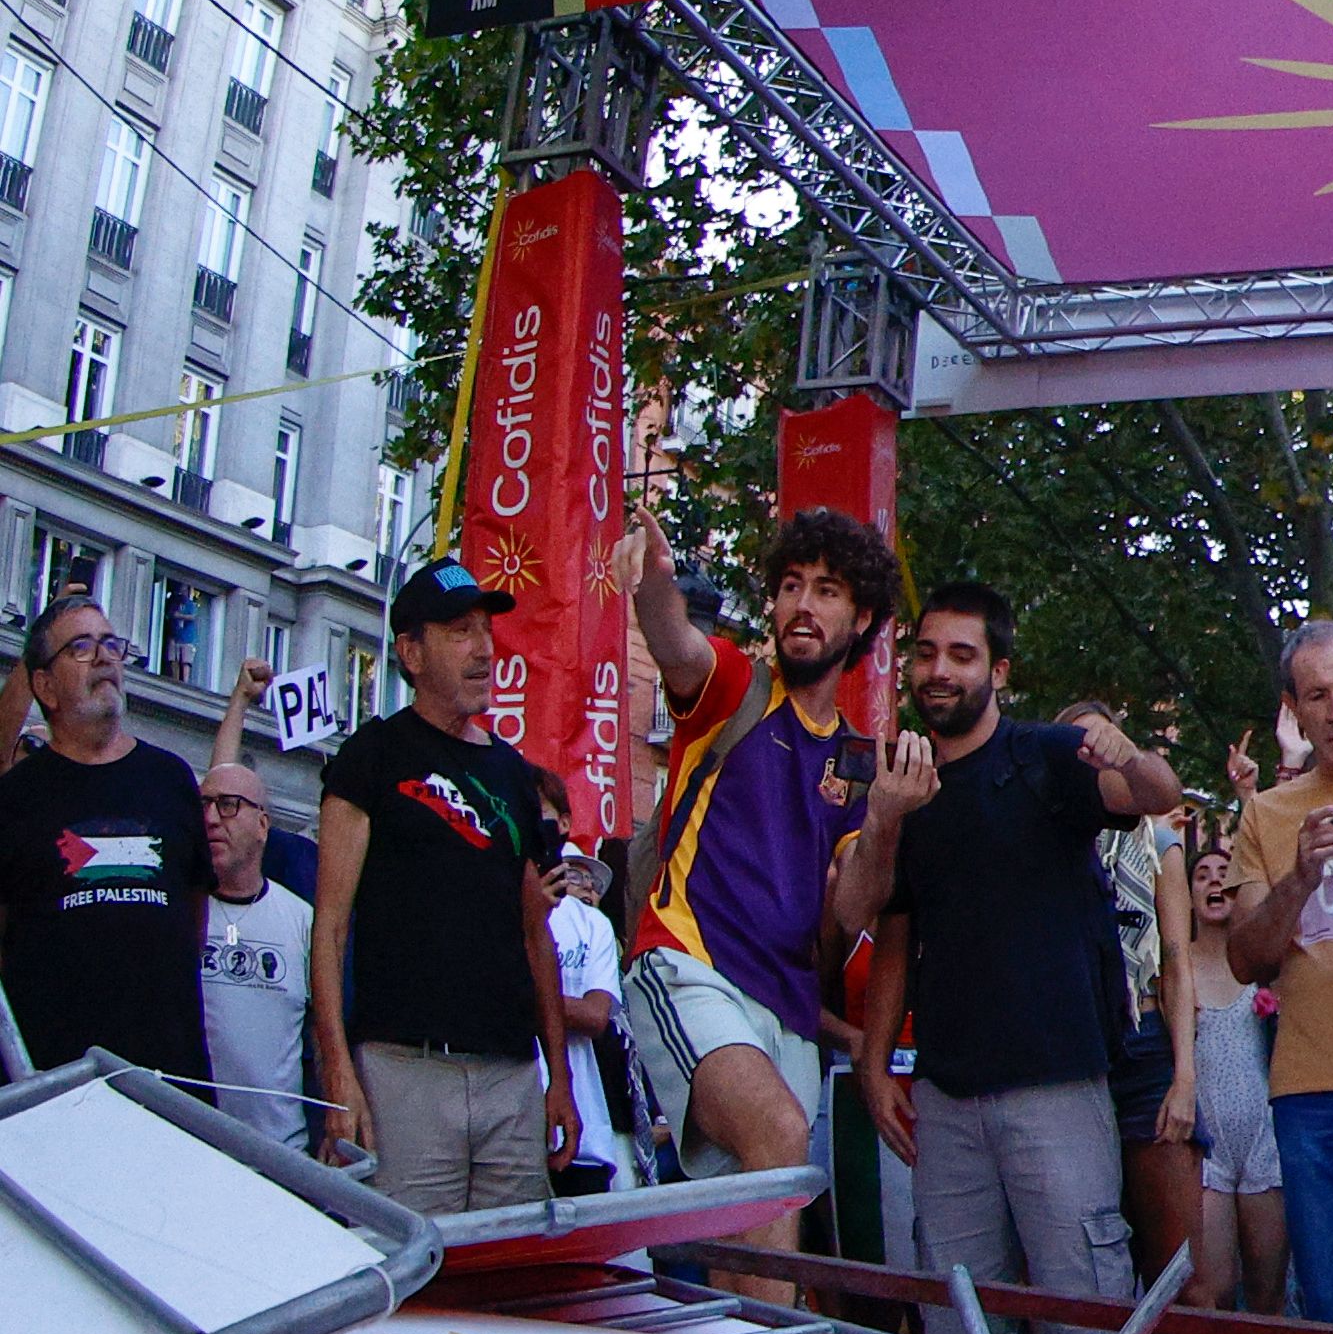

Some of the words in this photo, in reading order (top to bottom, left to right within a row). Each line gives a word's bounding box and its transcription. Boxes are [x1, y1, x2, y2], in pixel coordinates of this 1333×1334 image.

[492, 304, 541, 517] Cofidis
[588, 312, 611, 521] Cofidis
[279, 670, 333, 739] PAZ
[585, 661, 619, 859] ofidis
[63, 890, 93, 910] FREE
[96, 888, 168, 906] PALESTINE
